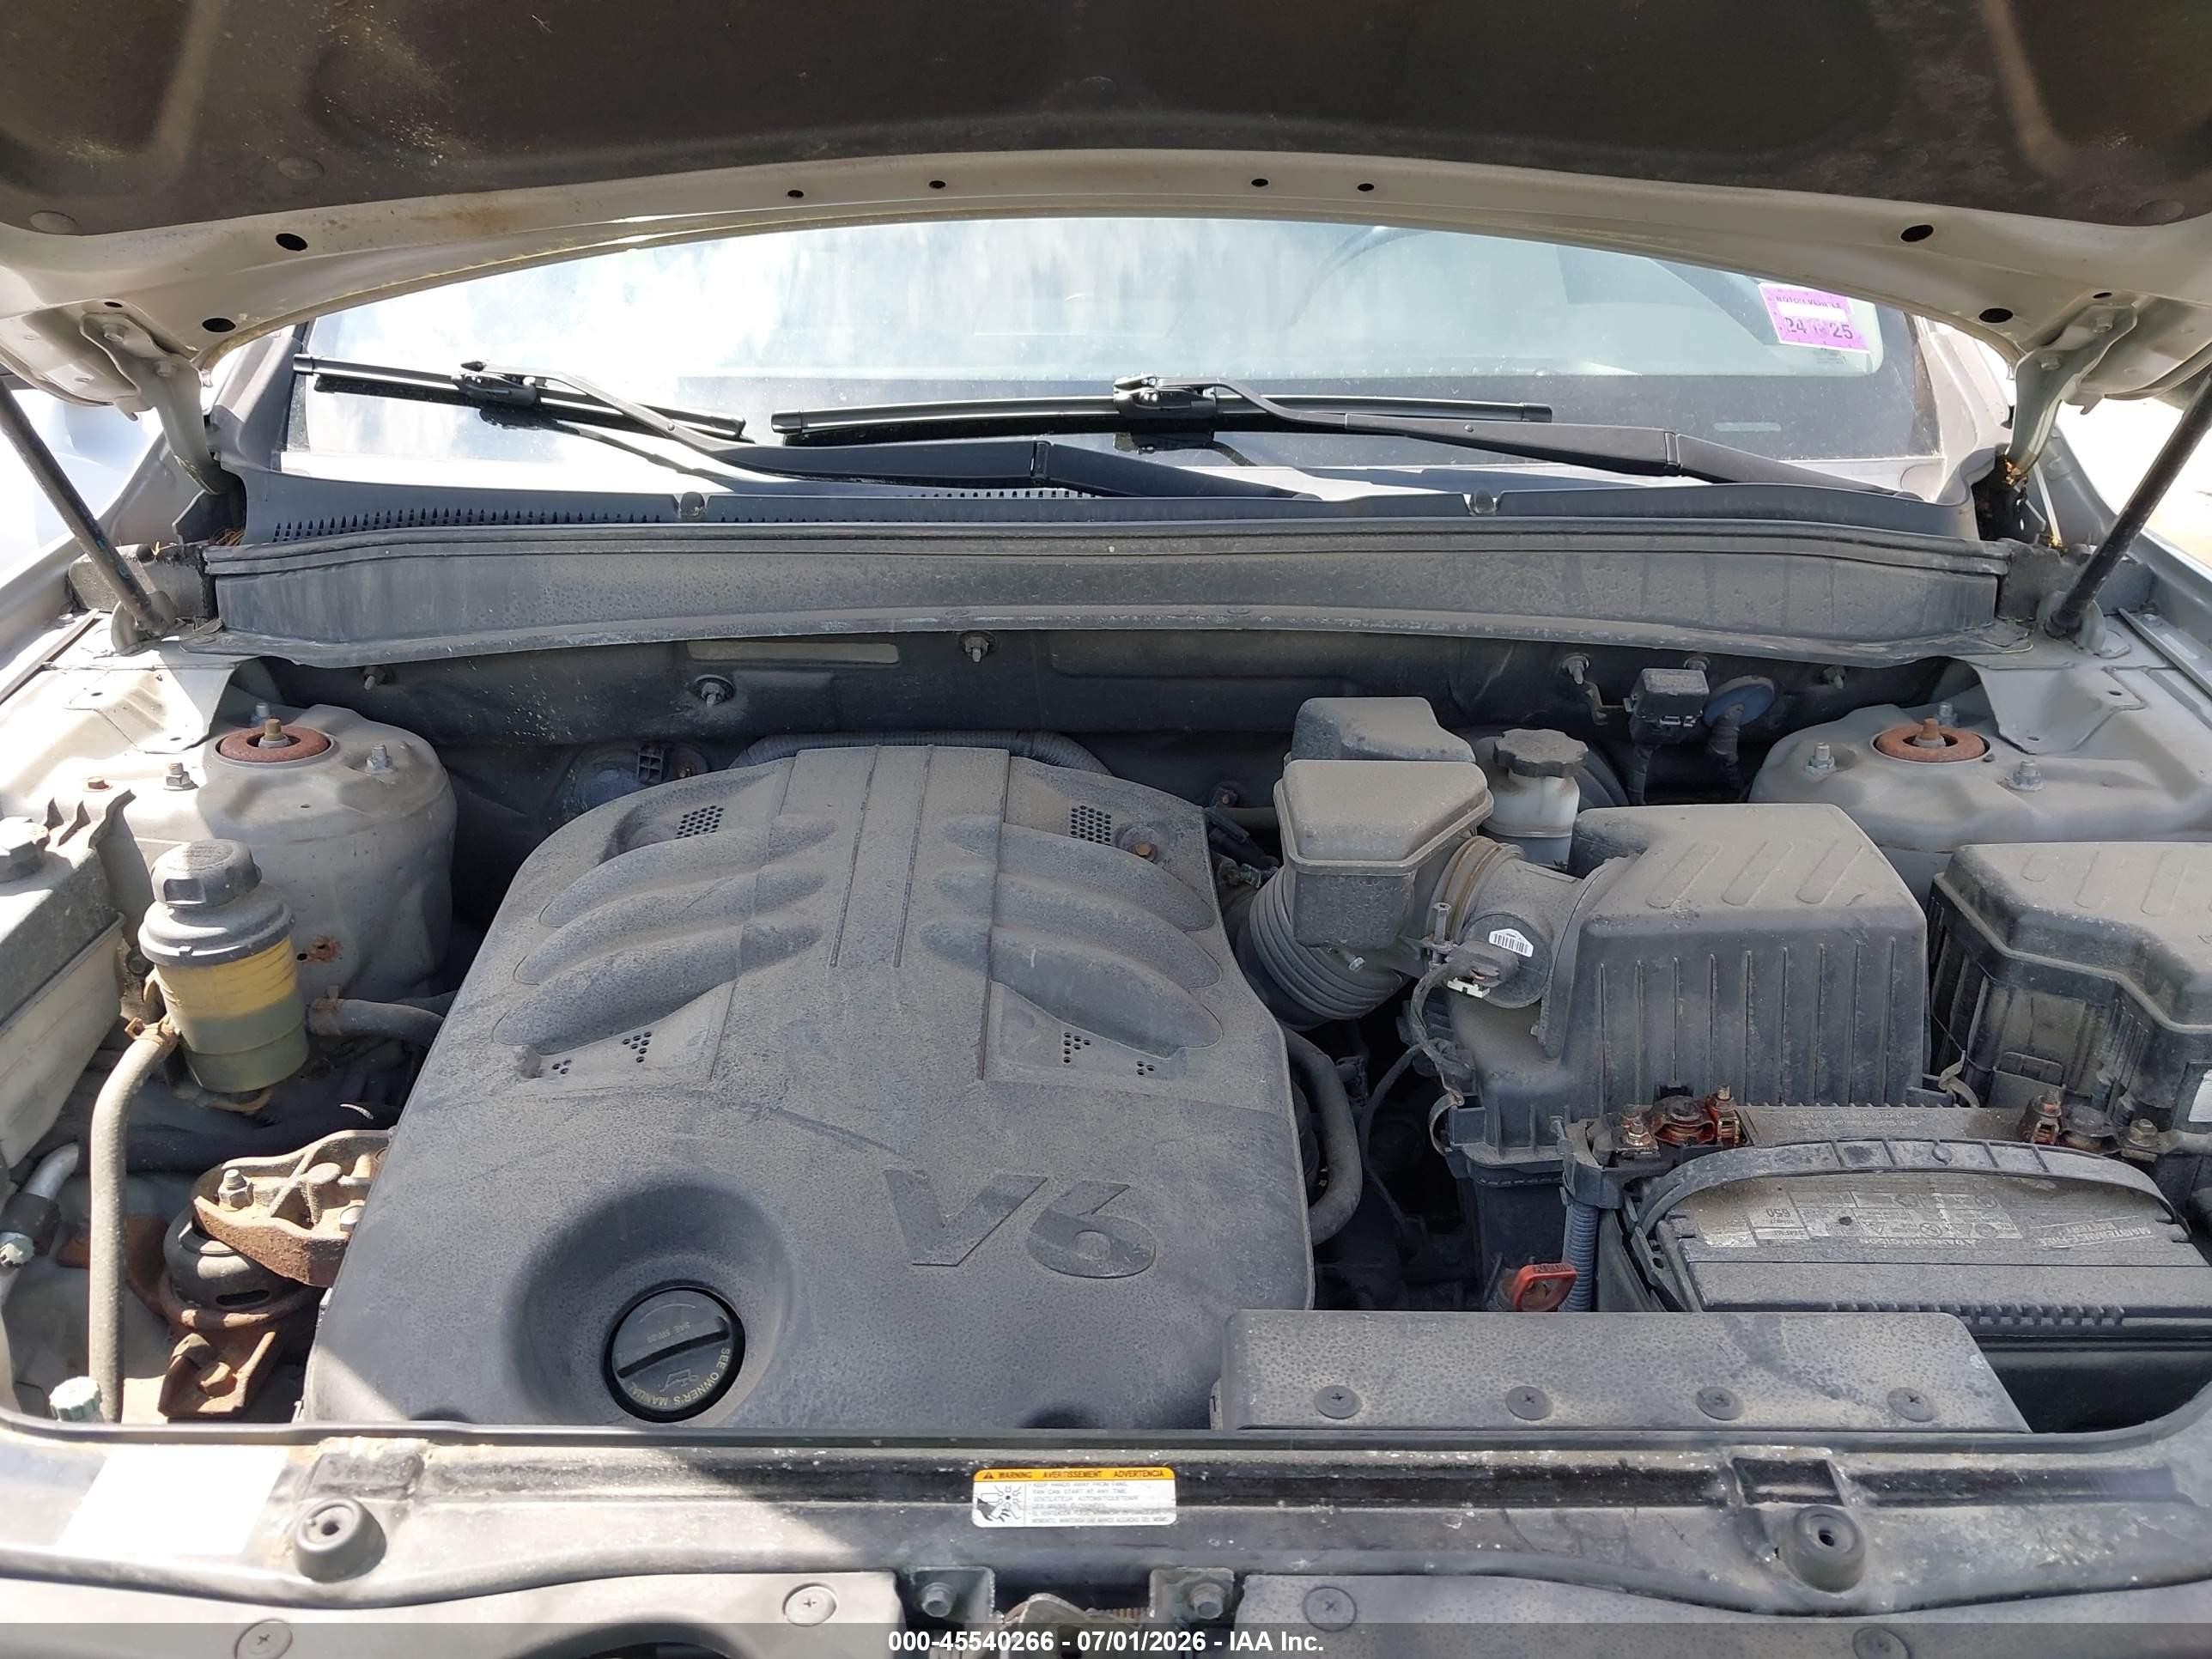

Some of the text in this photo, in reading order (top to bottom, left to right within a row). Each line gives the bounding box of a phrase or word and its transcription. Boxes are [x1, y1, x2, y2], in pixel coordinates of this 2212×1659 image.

[1784, 317, 1807, 334] 24
[1829, 322, 1853, 339] 25
[883, 1168, 1157, 1279] V6
[1766, 1207, 1790, 1218] 650
[629, 1347, 731, 1407] SEE OWNER'S MANUAL
